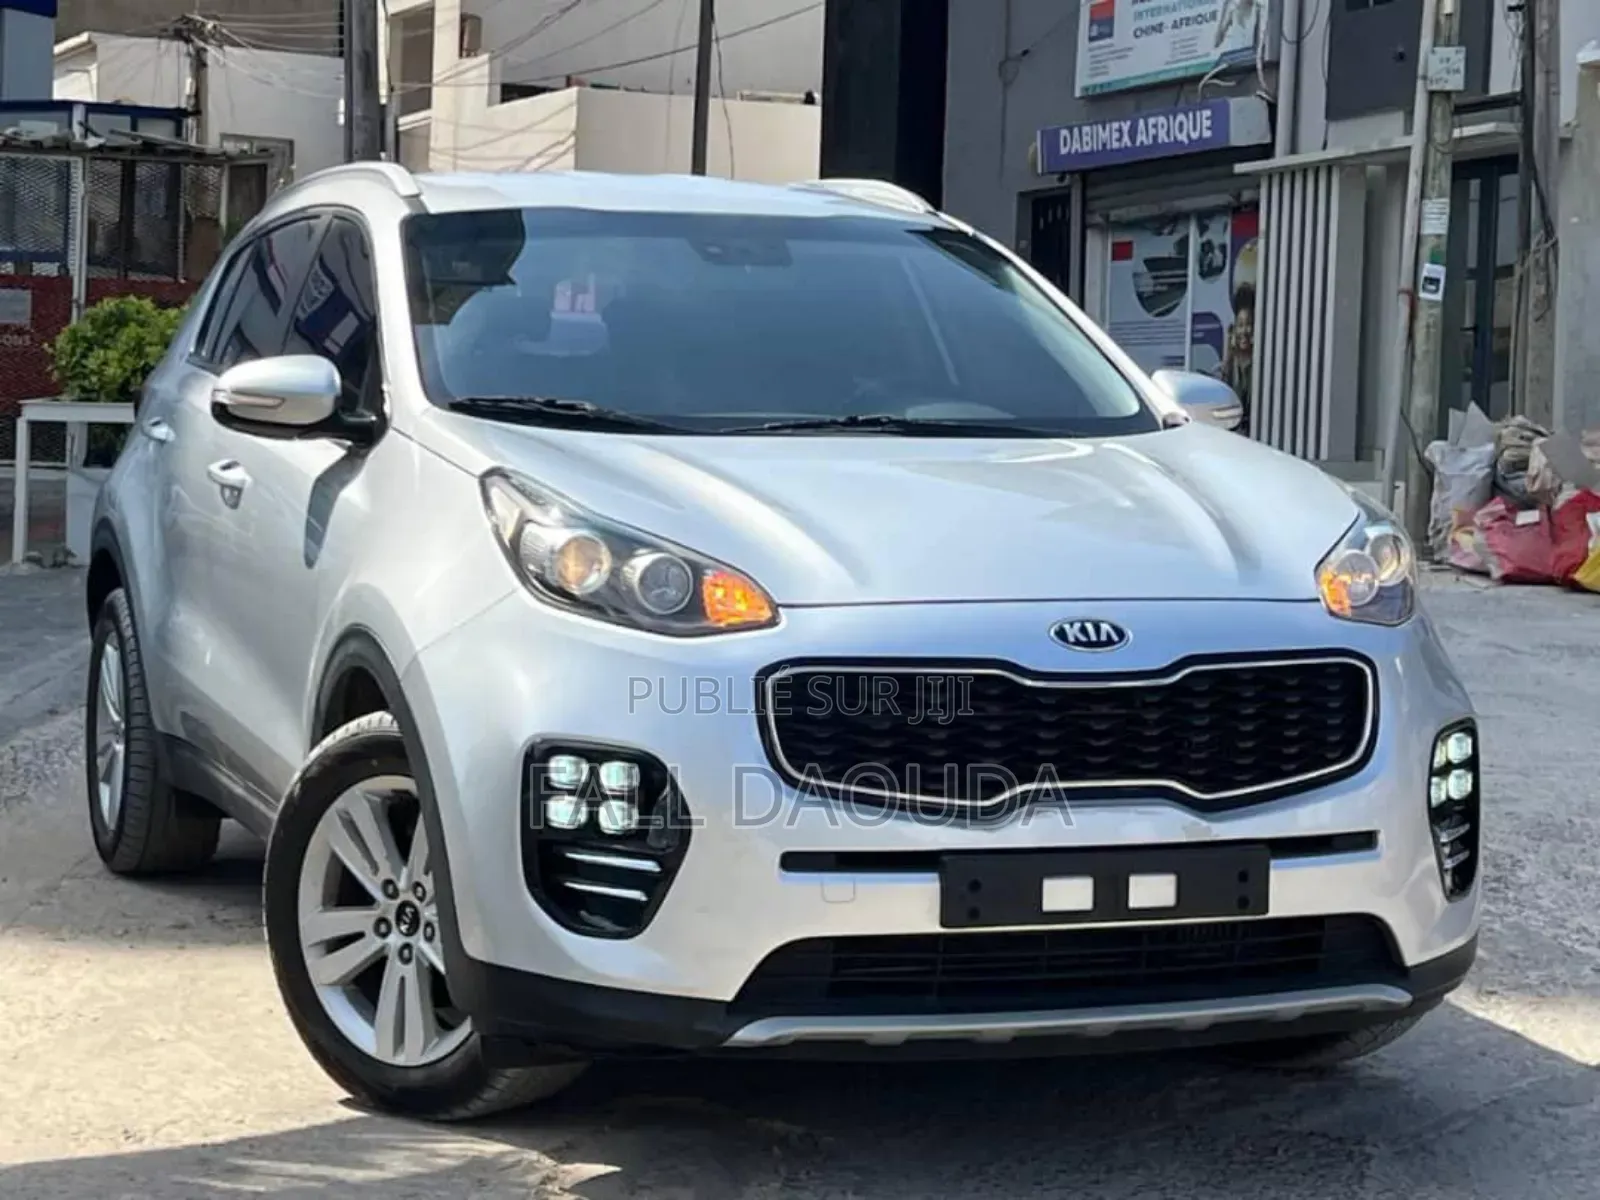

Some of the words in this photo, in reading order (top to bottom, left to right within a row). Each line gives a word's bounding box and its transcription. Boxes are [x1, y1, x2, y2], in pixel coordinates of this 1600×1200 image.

[1059, 120, 1131, 155] DABIMEX
[1136, 109, 1213, 145] AFRIQUE
[1063, 621, 1119, 643] KIA
